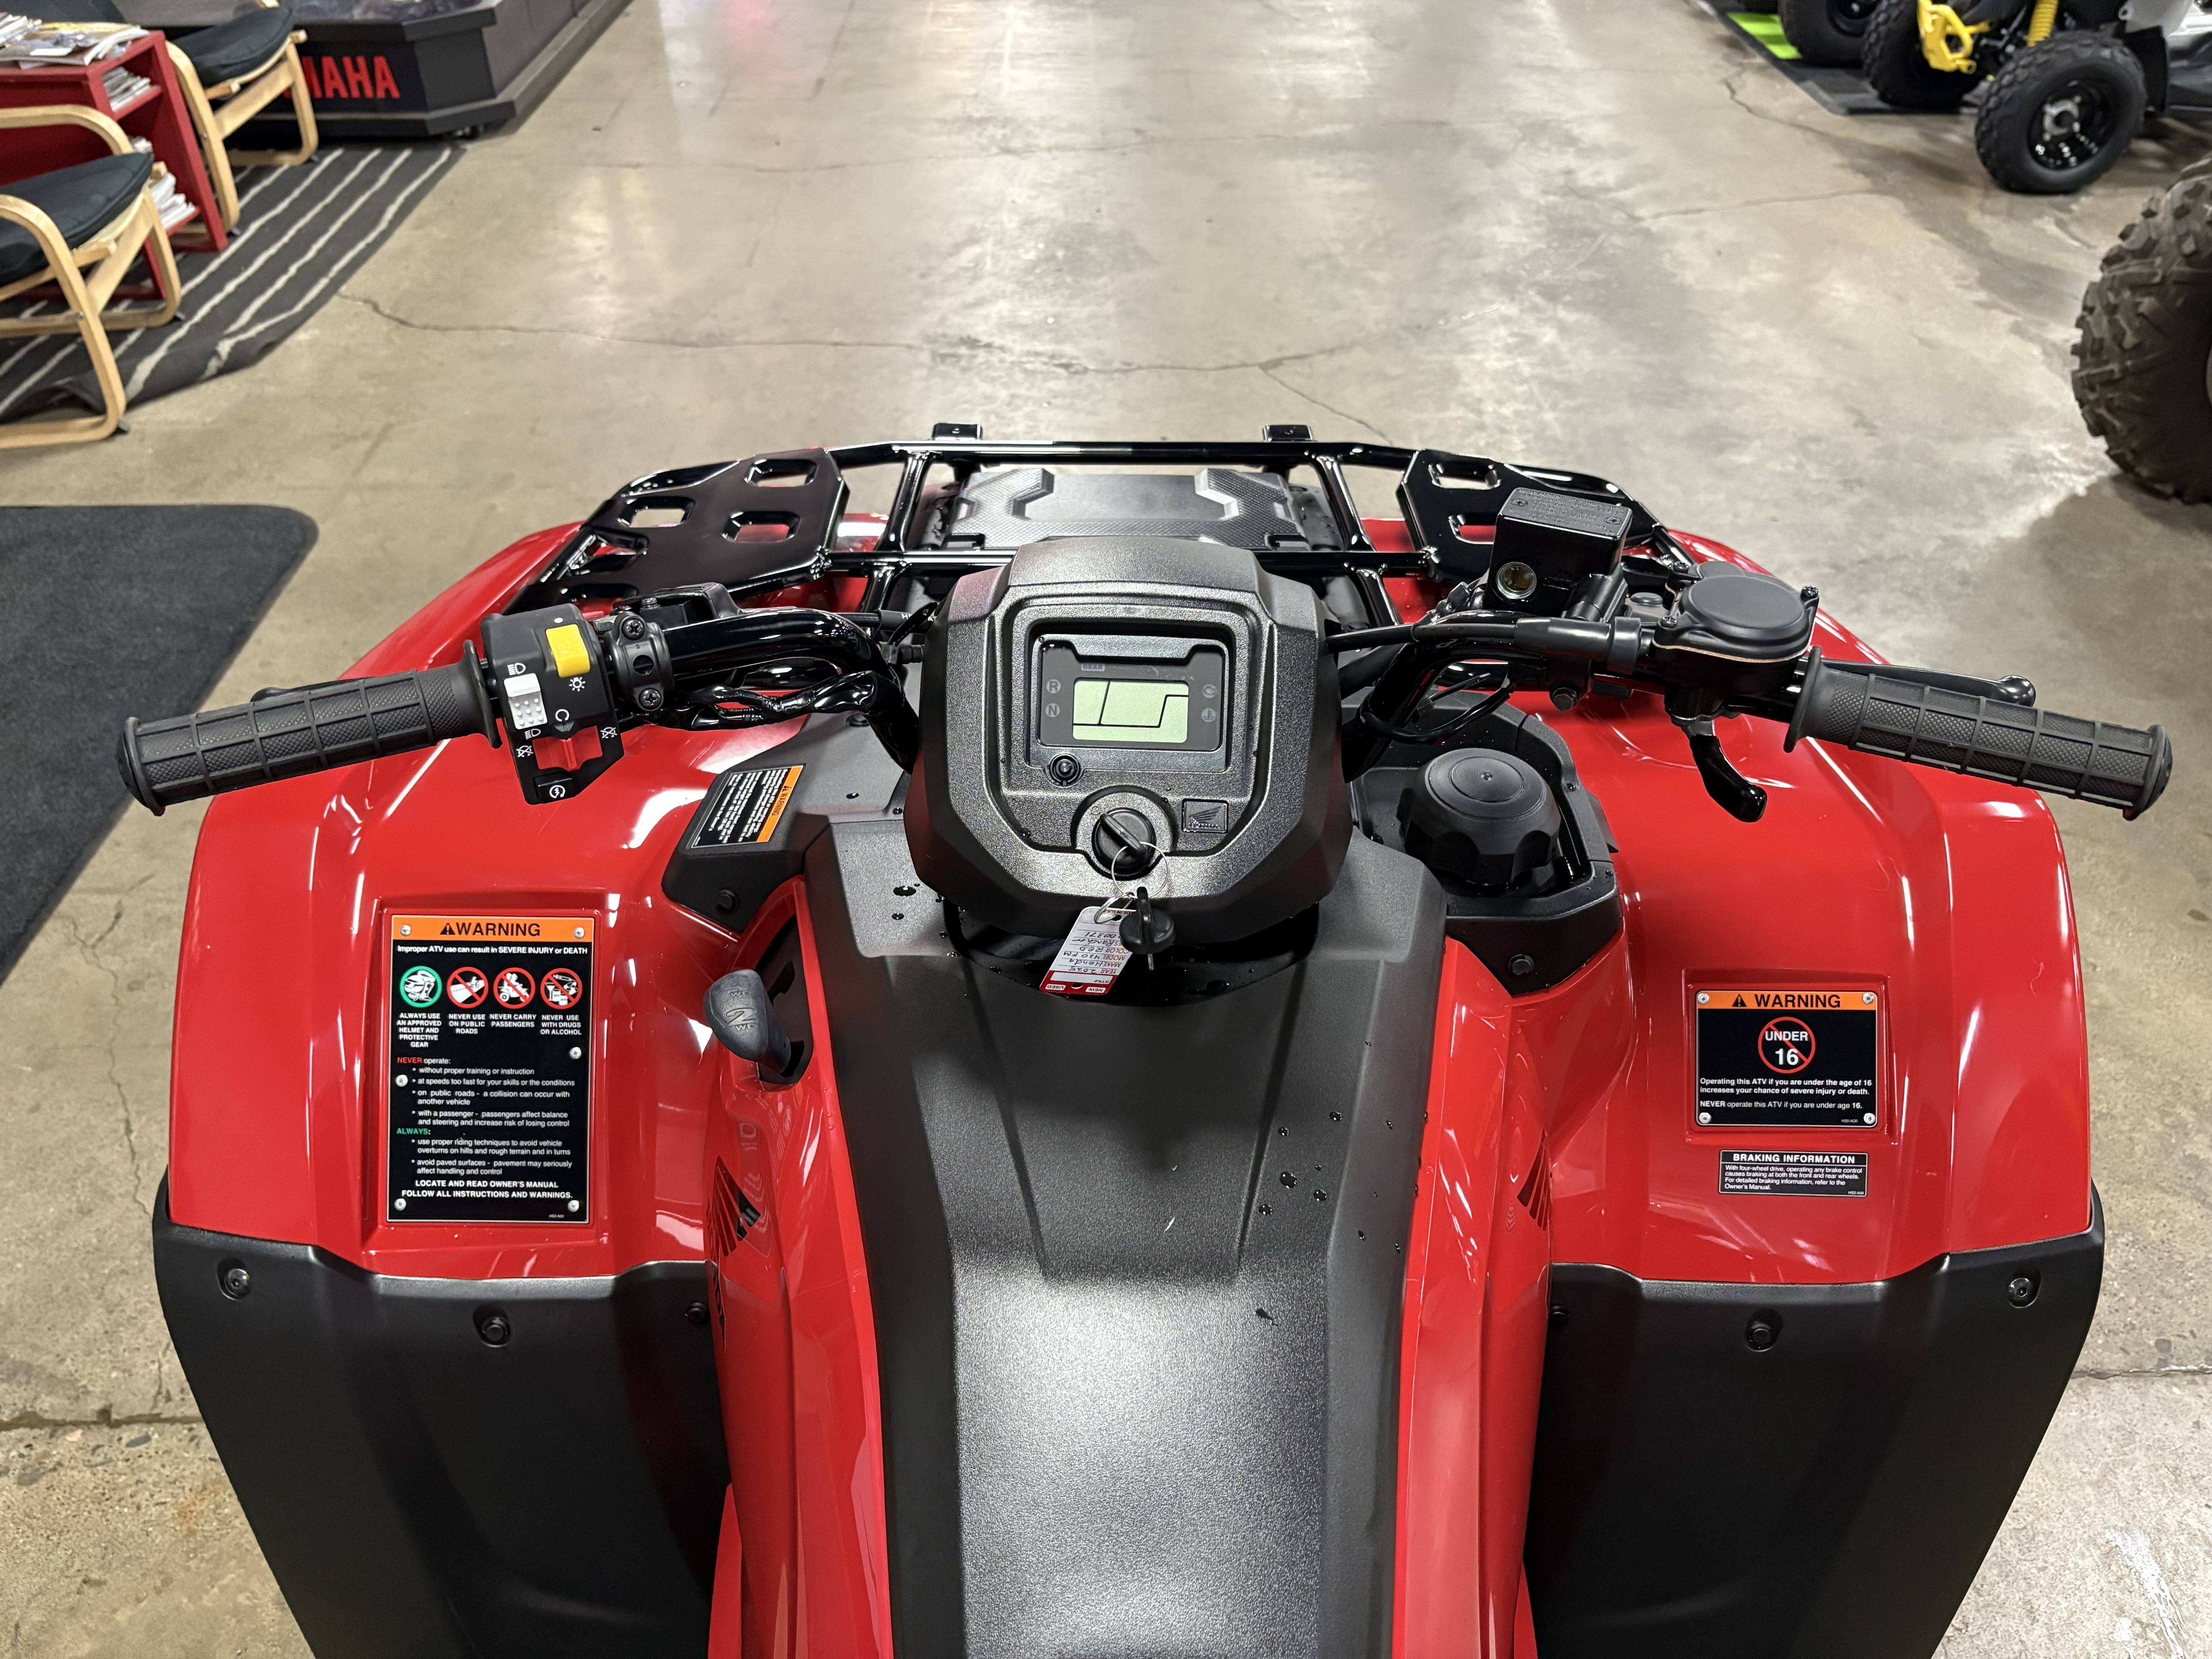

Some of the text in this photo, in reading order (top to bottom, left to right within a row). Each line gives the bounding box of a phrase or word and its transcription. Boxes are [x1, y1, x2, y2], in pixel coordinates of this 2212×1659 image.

[1049, 680, 1058, 692] R
[1048, 705, 1058, 716] N
[772, 793, 788, 816] WARNING
[456, 922, 540, 937] WARNING
[1084, 931, 1120, 939] 00371
[397, 945, 428, 953] Improper
[1068, 958, 1103, 967] Honda
[1754, 994, 1840, 1008] WARNING
[726, 1007, 757, 1026] 2
[1765, 1031, 1808, 1041] UNDER
[1775, 1048, 1798, 1065] 16
[466, 1067, 491, 1075] training
[1700, 1077, 1735, 1086] Operating
[430, 1089, 451, 1097] public
[1815, 1087, 1836, 1096] injury
[1733, 1153, 1855, 1164] BRAKING INFORMATION
